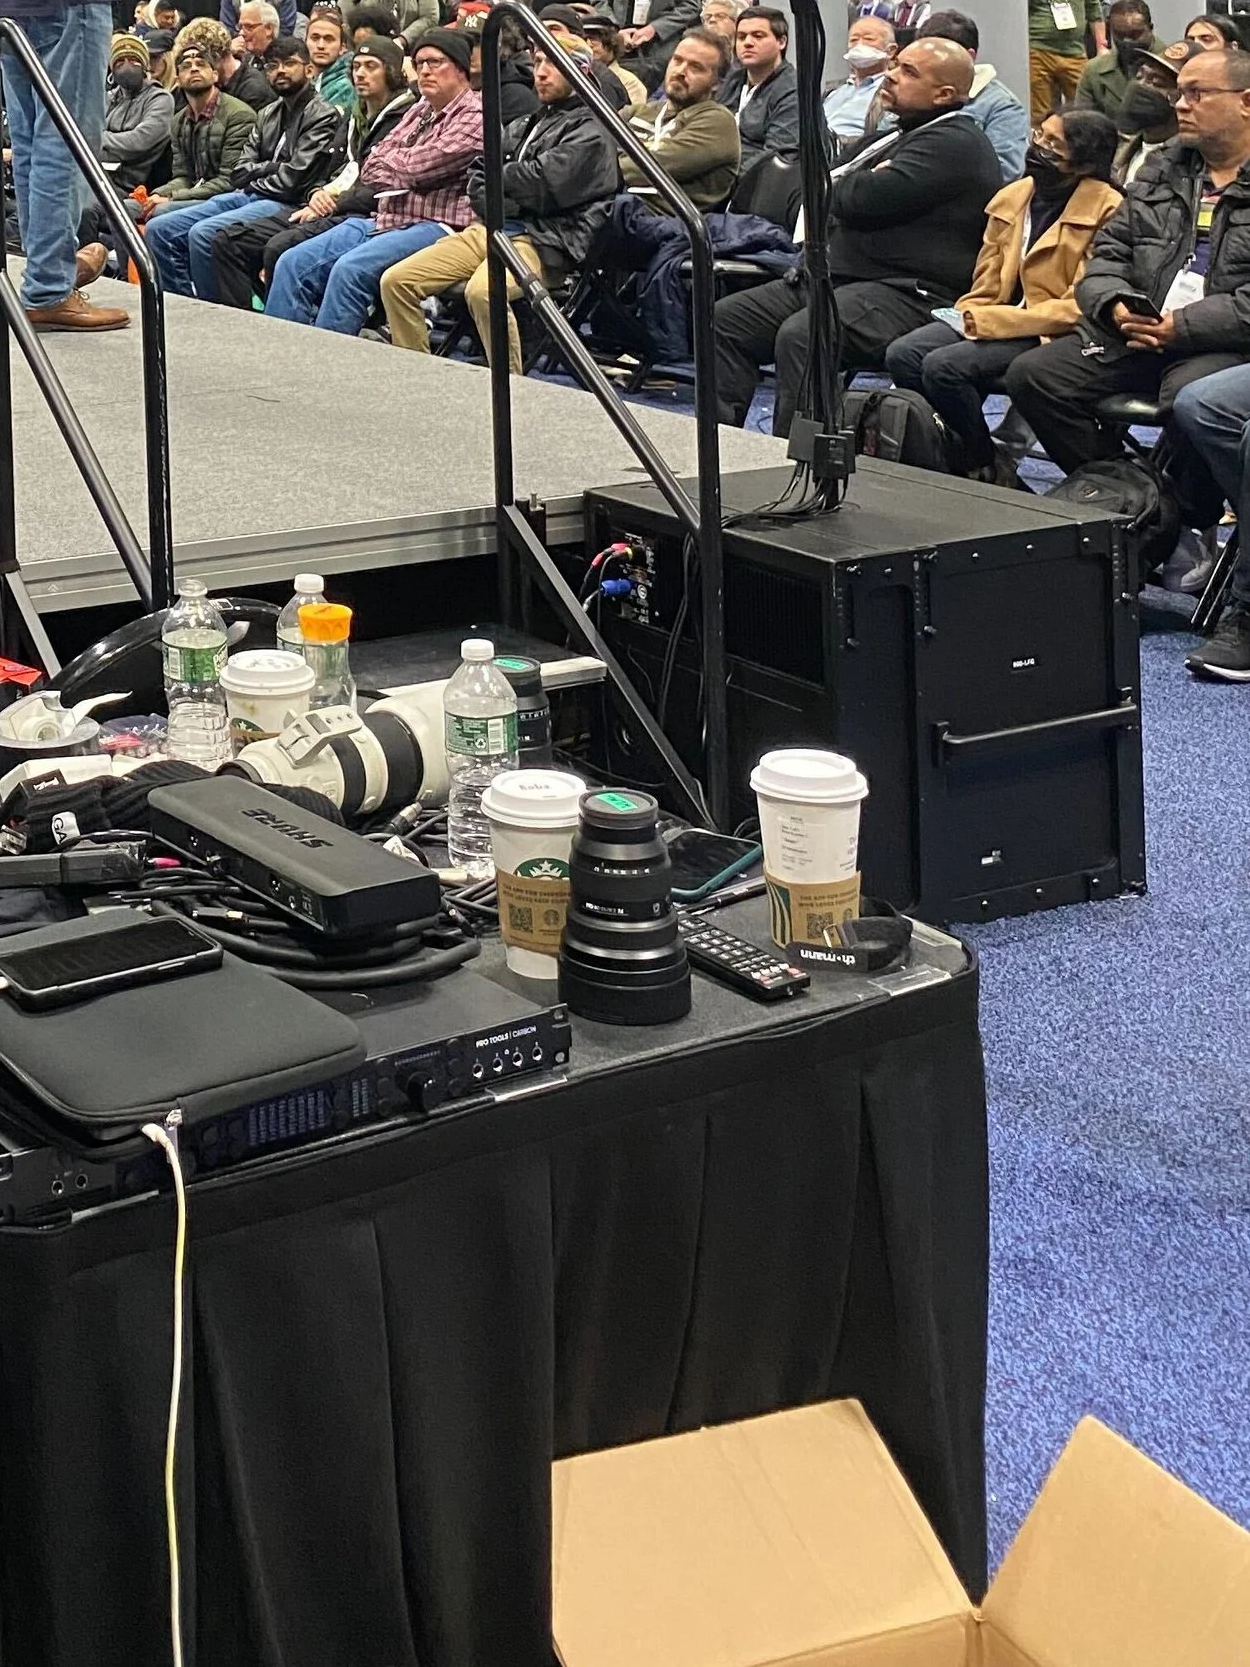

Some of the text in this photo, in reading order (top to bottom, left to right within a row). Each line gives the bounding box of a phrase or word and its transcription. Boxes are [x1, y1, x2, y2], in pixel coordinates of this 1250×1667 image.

[242, 808, 334, 848] SHURE
[475, 1025, 537, 1048] PRO TOOLS CARBON
